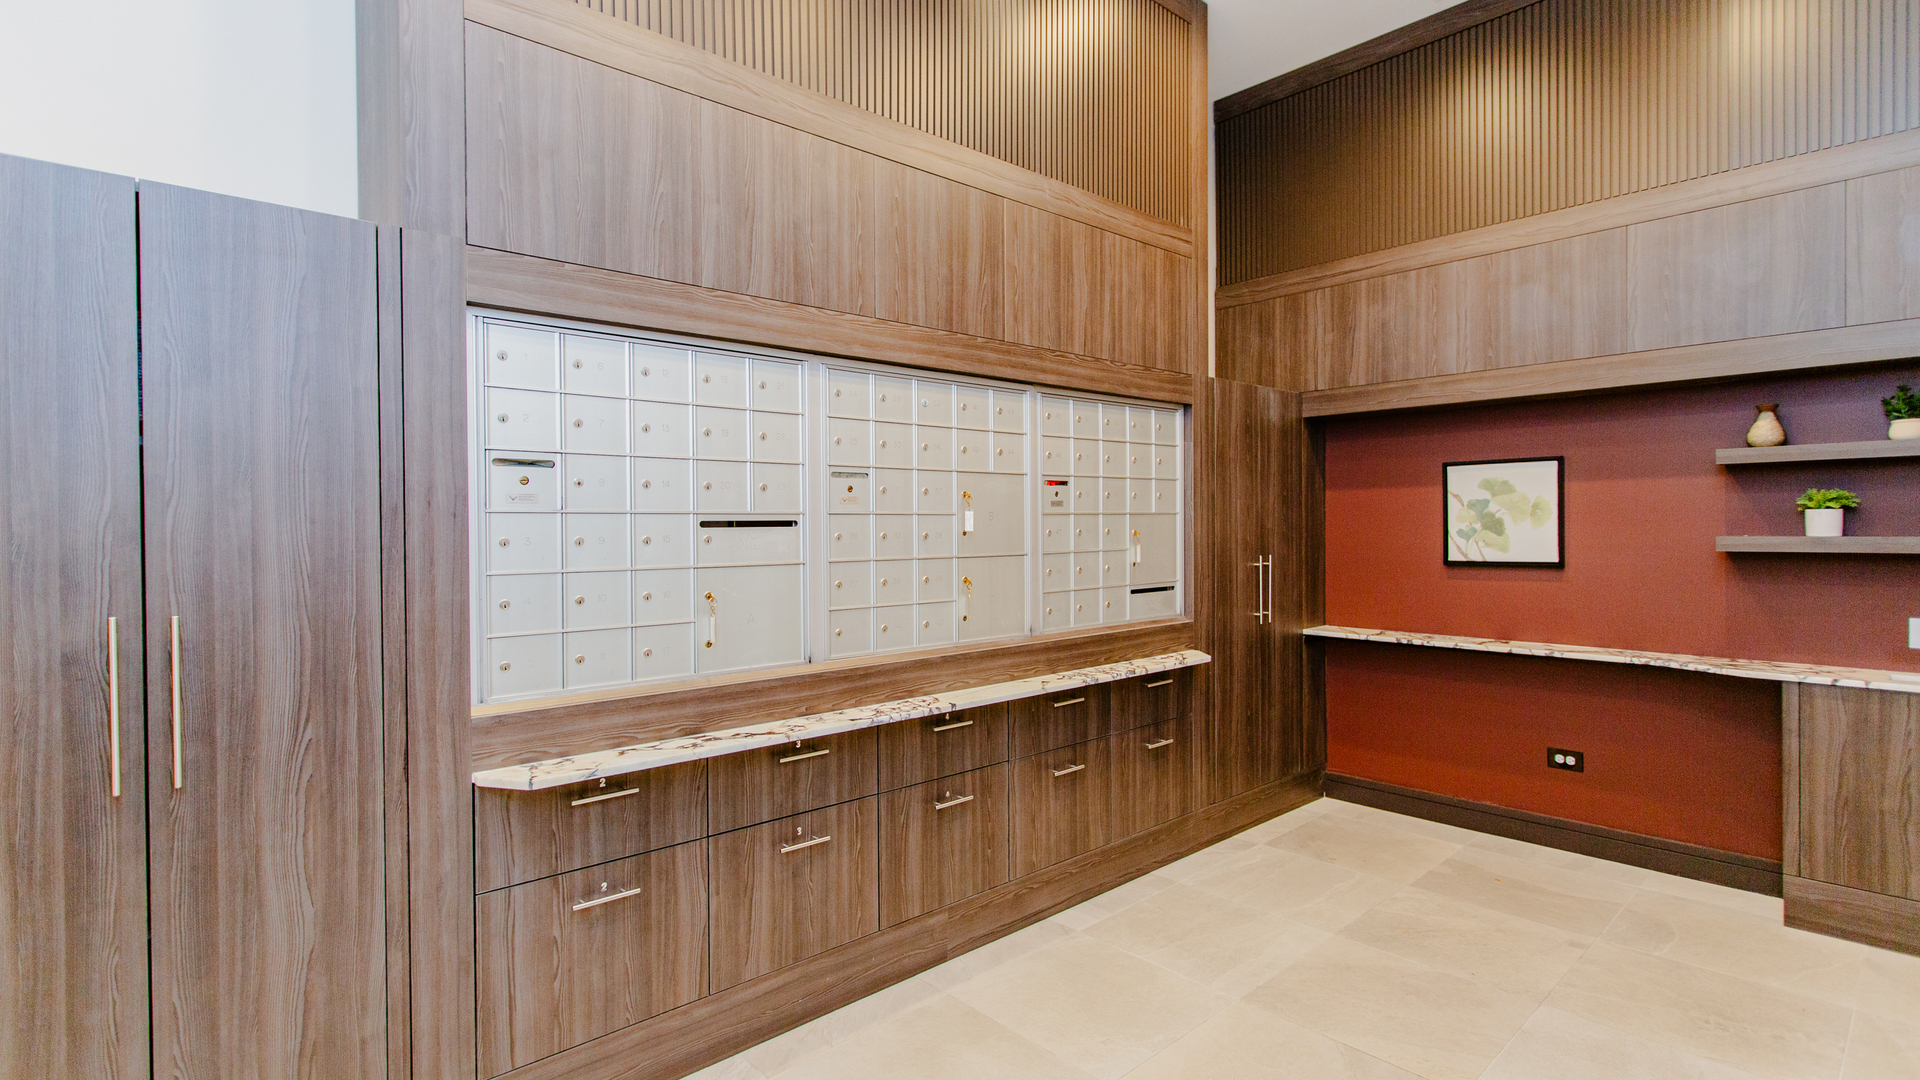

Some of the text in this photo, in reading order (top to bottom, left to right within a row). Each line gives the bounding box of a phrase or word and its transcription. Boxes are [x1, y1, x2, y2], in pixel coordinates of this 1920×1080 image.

[597, 361, 604, 371] 6
[661, 368, 670, 378] 12
[720, 375, 728, 384] 18
[776, 382, 785, 390] 21
[522, 413, 530, 423] 2
[599, 419, 605, 428] 7
[661, 423, 670, 433] 13
[721, 428, 729, 438] 19
[776, 432, 786, 441] 22
[599, 478, 605, 487] 8
[661, 480, 670, 489] 14
[720, 481, 731, 490] 20
[776, 482, 786, 491] 23
[988, 512, 995, 521] B
[524, 536, 531, 546] 3
[598, 536, 605, 545] 9
[662, 535, 671, 544] 15
[598, 593, 607, 603] 10
[663, 590, 671, 599] 16
[524, 596, 531, 606] 4
[746, 614, 755, 624] A
[663, 645, 670, 655] 17
[600, 652, 606, 661] 11
[527, 658, 534, 668] 5
[599, 778, 606, 788] 2
[796, 826, 803, 836] 3
[600, 882, 608, 892] 2
